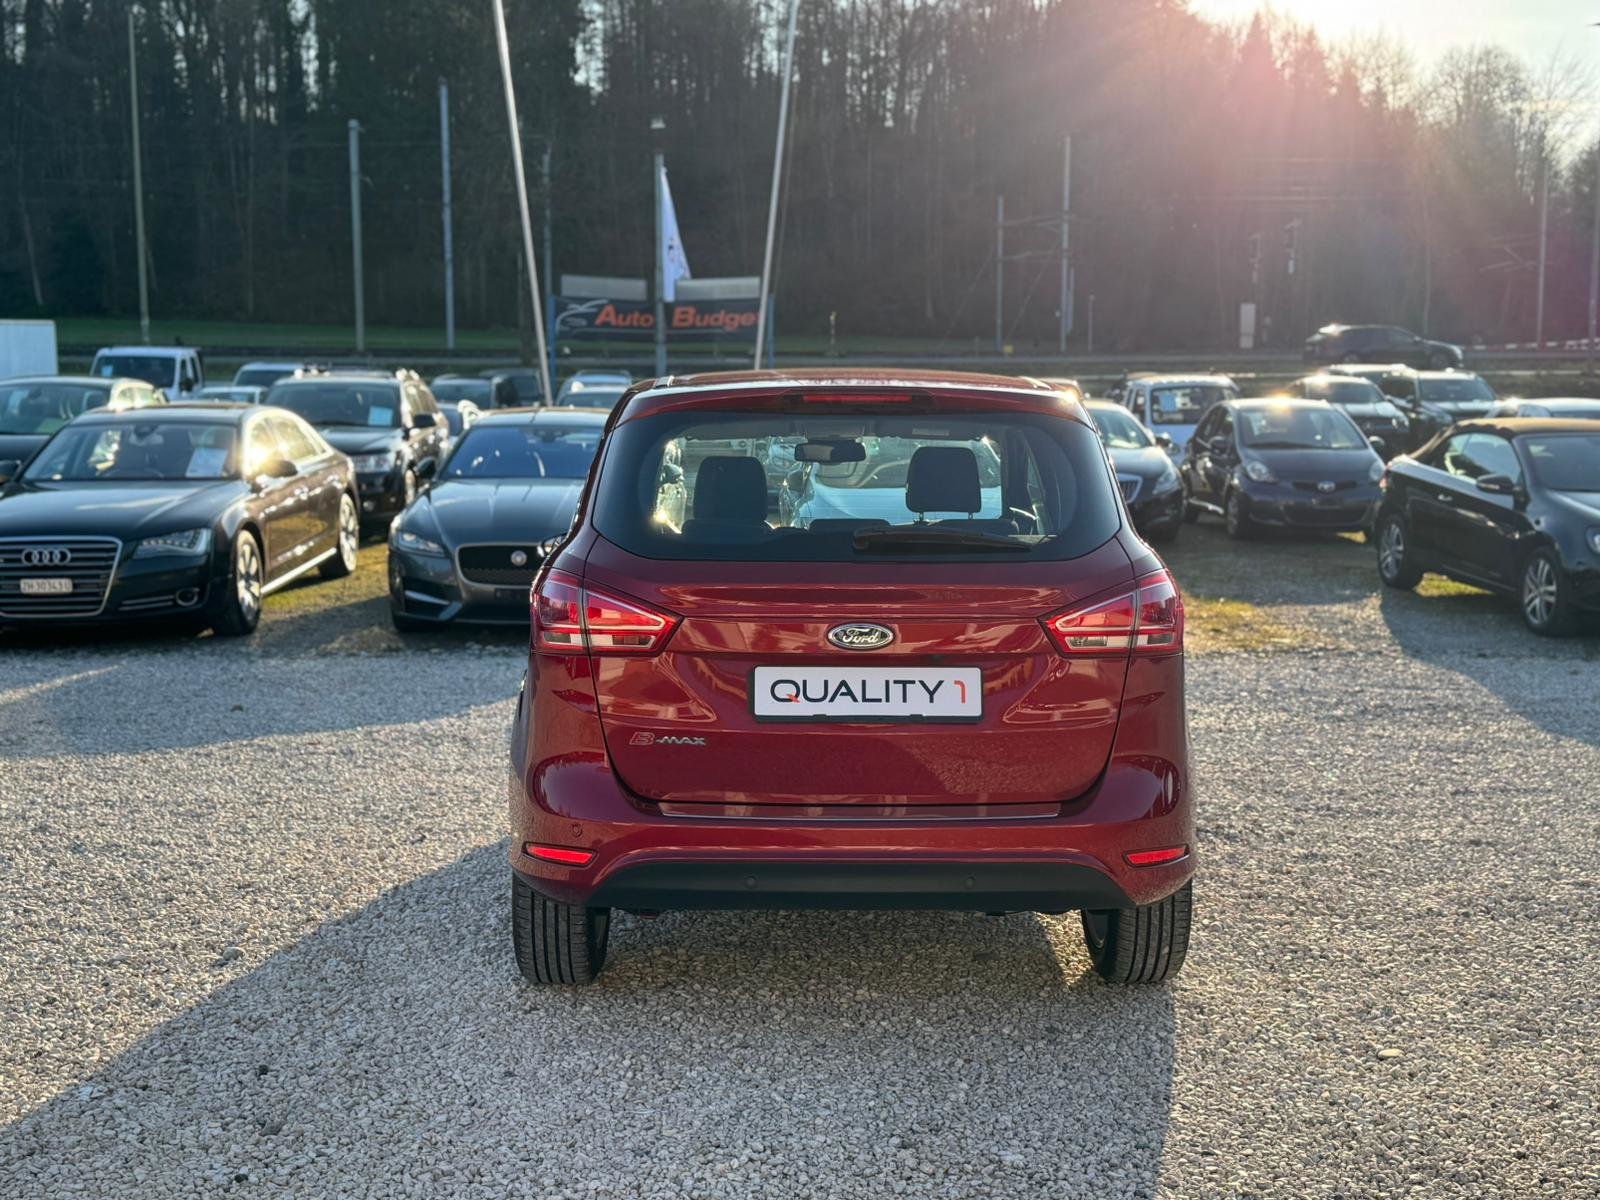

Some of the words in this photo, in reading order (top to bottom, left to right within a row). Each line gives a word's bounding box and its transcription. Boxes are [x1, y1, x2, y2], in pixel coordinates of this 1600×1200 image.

[595, 303, 654, 329] Auto
[842, 628, 879, 643] Ford
[770, 679, 945, 704] QUALITY
[954, 679, 967, 704] 1
